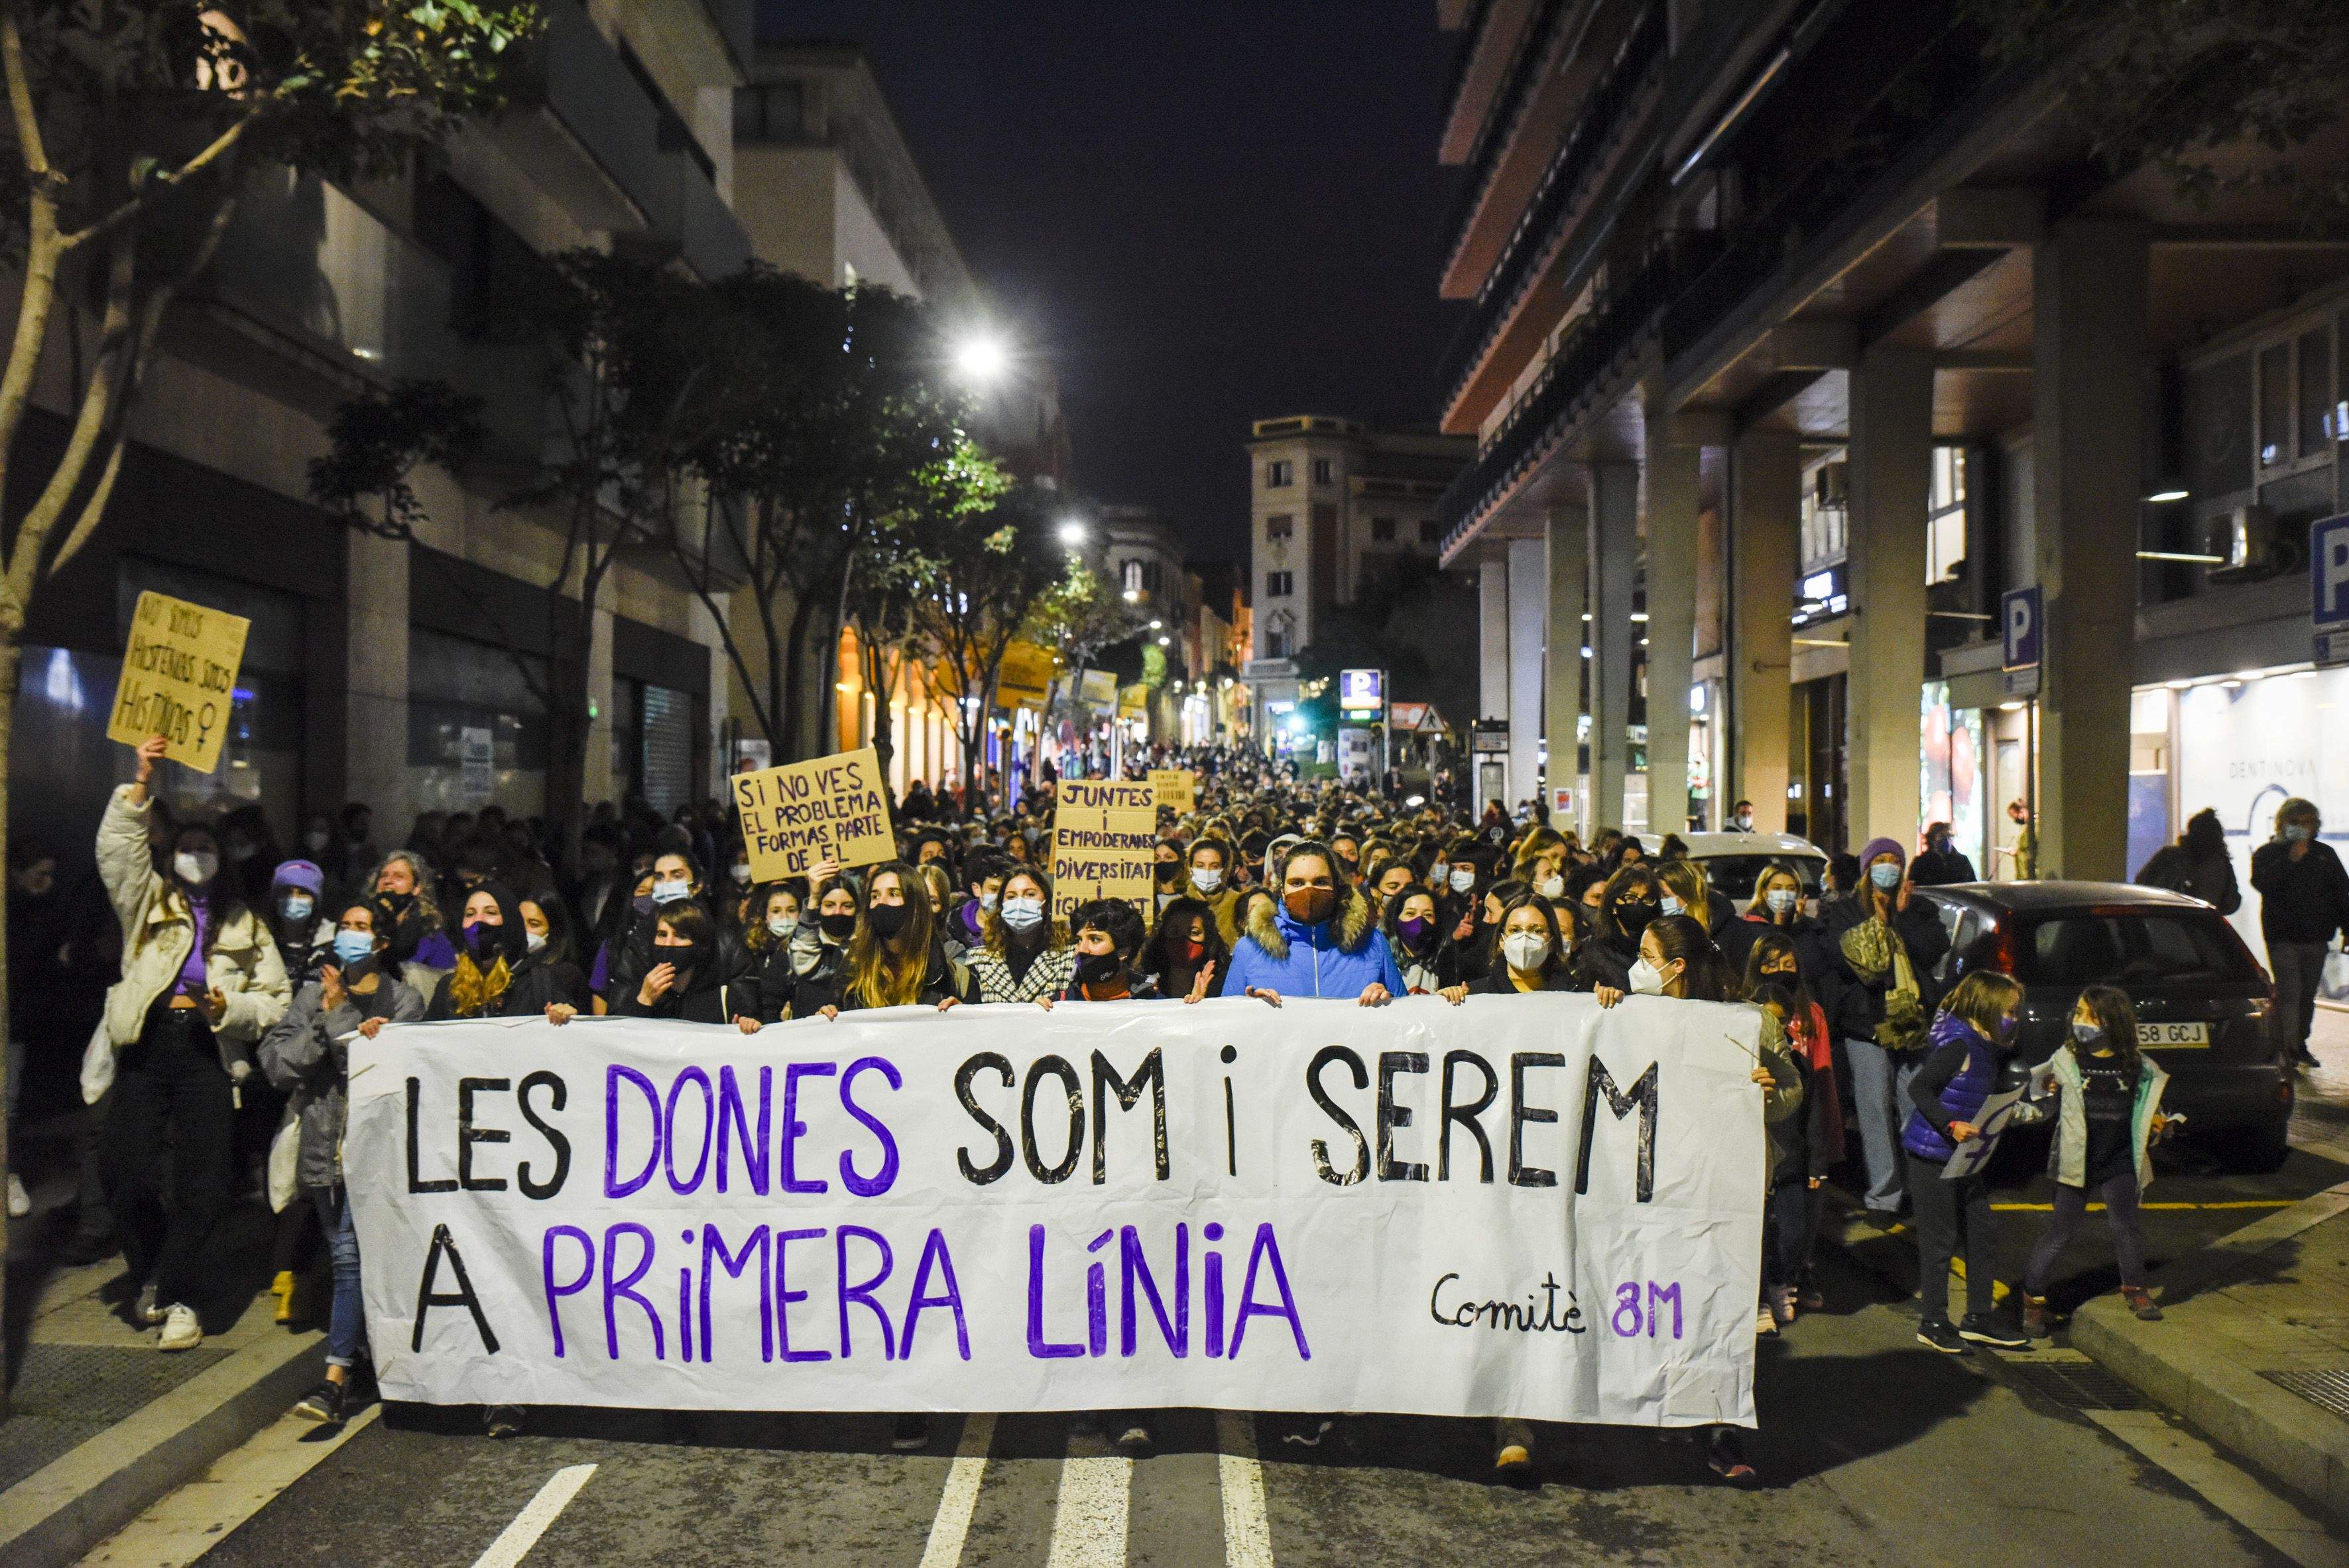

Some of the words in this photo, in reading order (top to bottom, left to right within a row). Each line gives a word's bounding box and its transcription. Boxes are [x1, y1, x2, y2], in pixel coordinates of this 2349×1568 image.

[2324, 528, 2349, 613] P
[2008, 599, 2031, 661] P
[1351, 672, 1371, 697] P
[776, 775, 810, 804] NO
[815, 762, 863, 795] VES
[1062, 785, 1153, 807] JUNTES
[743, 812, 768, 835] EL
[775, 790, 882, 827] PROBLEMA
[756, 825, 829, 855] FORMAS
[835, 814, 884, 841] PARTE
[1057, 828, 1156, 849] EMPODERADES
[786, 849, 811, 873] DE
[2167, 1025, 2201, 1042] GCJ
[405, 1070, 571, 1199] LES
[604, 1055, 903, 1198] DONES
[954, 1046, 1171, 1185] SOM
[1305, 1045, 1659, 1203] SEREM
[412, 1223, 501, 1355] A
[1611, 1280, 1683, 1340] 8M
